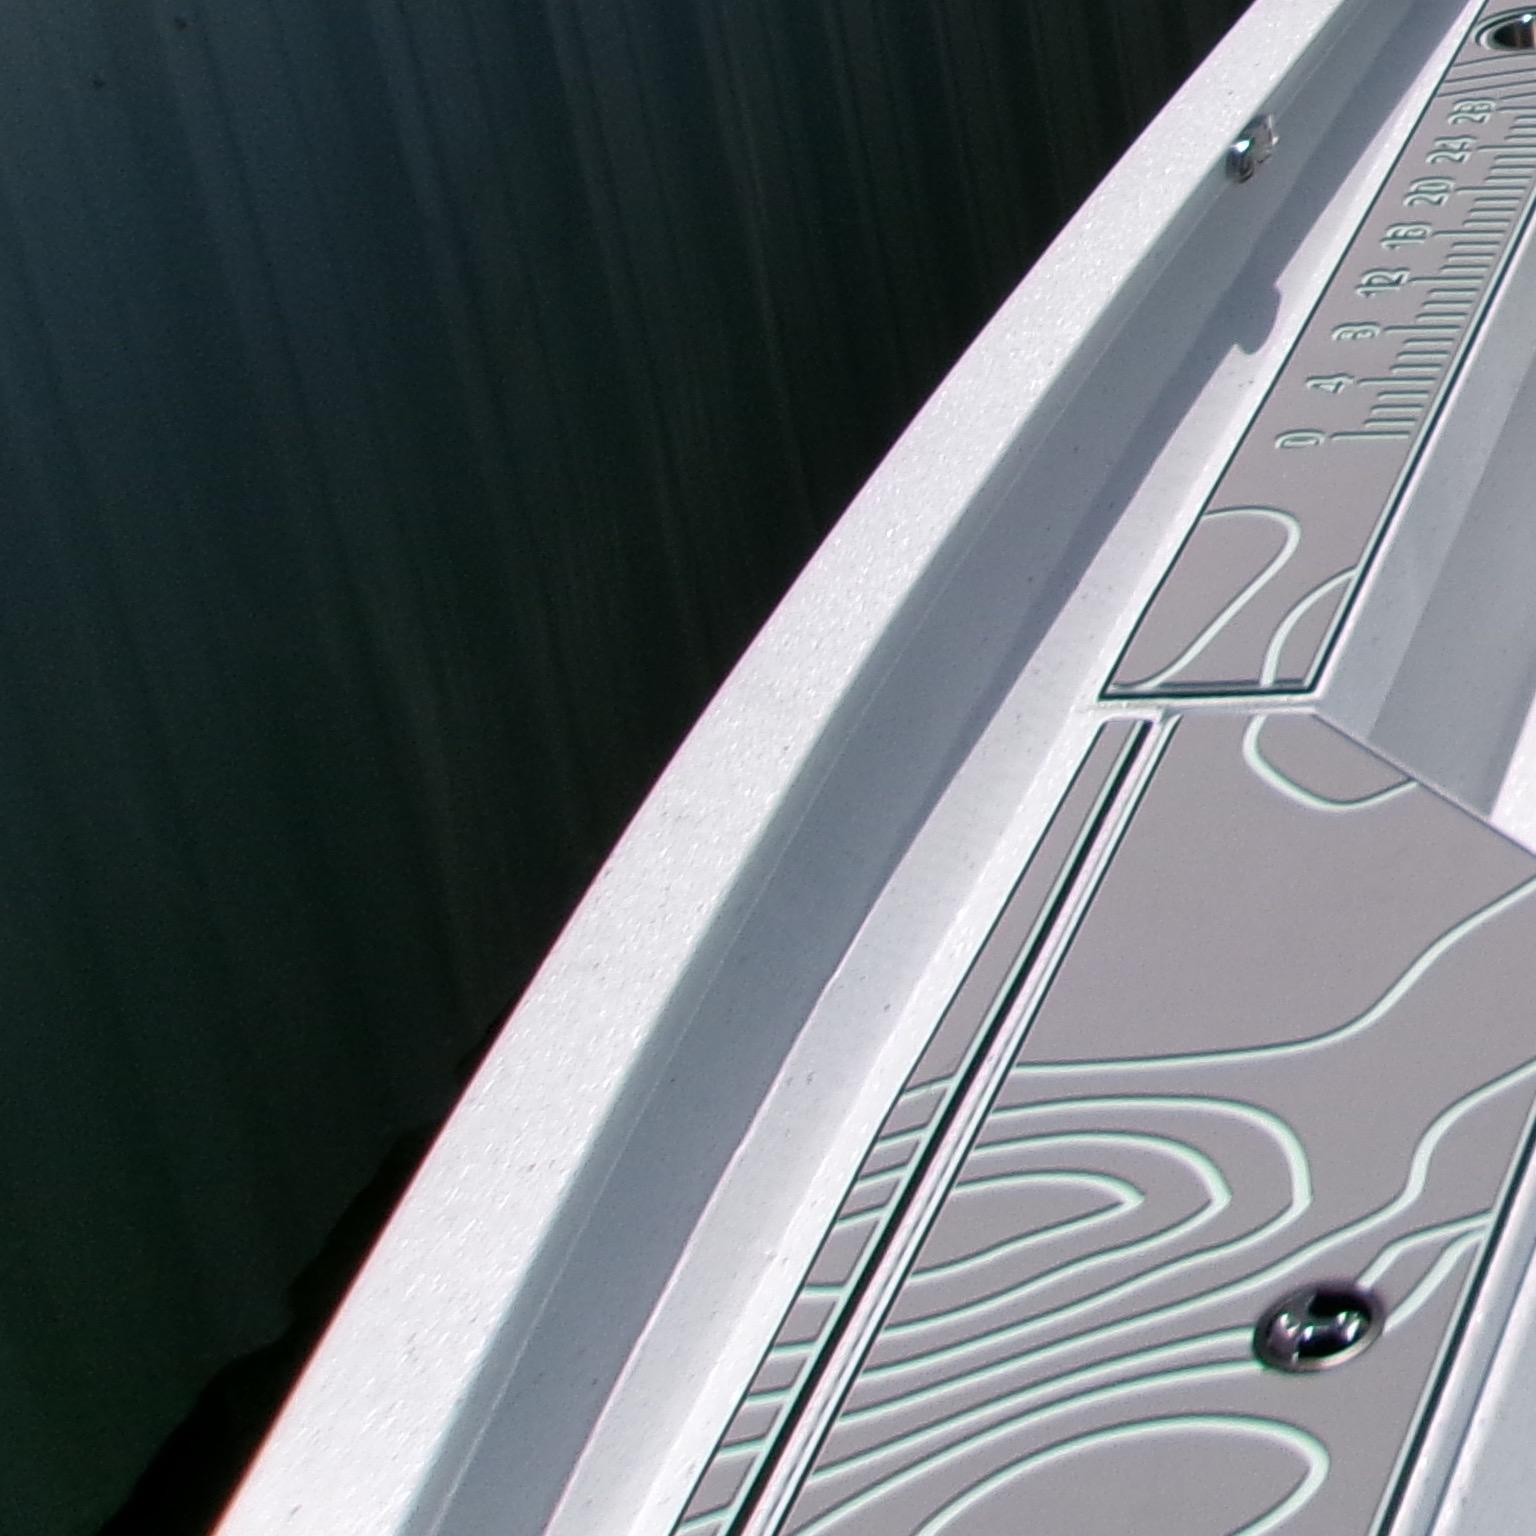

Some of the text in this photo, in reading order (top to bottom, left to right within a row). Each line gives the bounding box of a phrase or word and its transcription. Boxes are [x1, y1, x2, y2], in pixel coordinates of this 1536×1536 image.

[1448, 97, 1497, 125] 28
[1426, 135, 1477, 164] 24
[1403, 176, 1455, 207] 20
[1356, 268, 1410, 298] 12
[1306, 373, 1355, 394] 4
